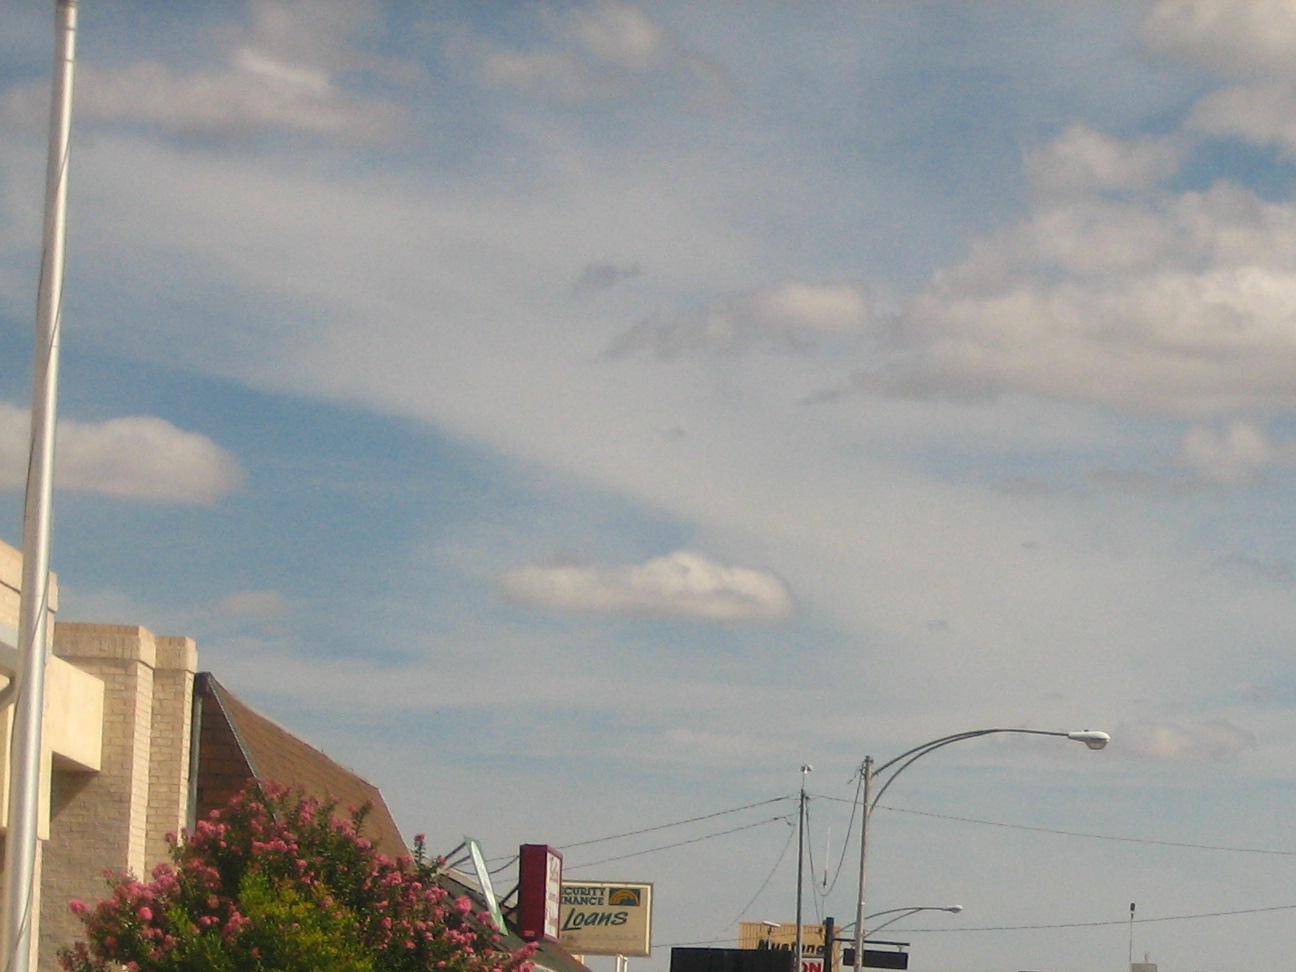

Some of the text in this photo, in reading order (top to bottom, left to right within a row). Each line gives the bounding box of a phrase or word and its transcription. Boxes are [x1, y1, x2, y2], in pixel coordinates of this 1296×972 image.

[561, 886, 606, 897] CURITY
[561, 896, 605, 906] NANCE
[560, 907, 629, 932] Loans
[757, 938, 826, 955] Mustng
